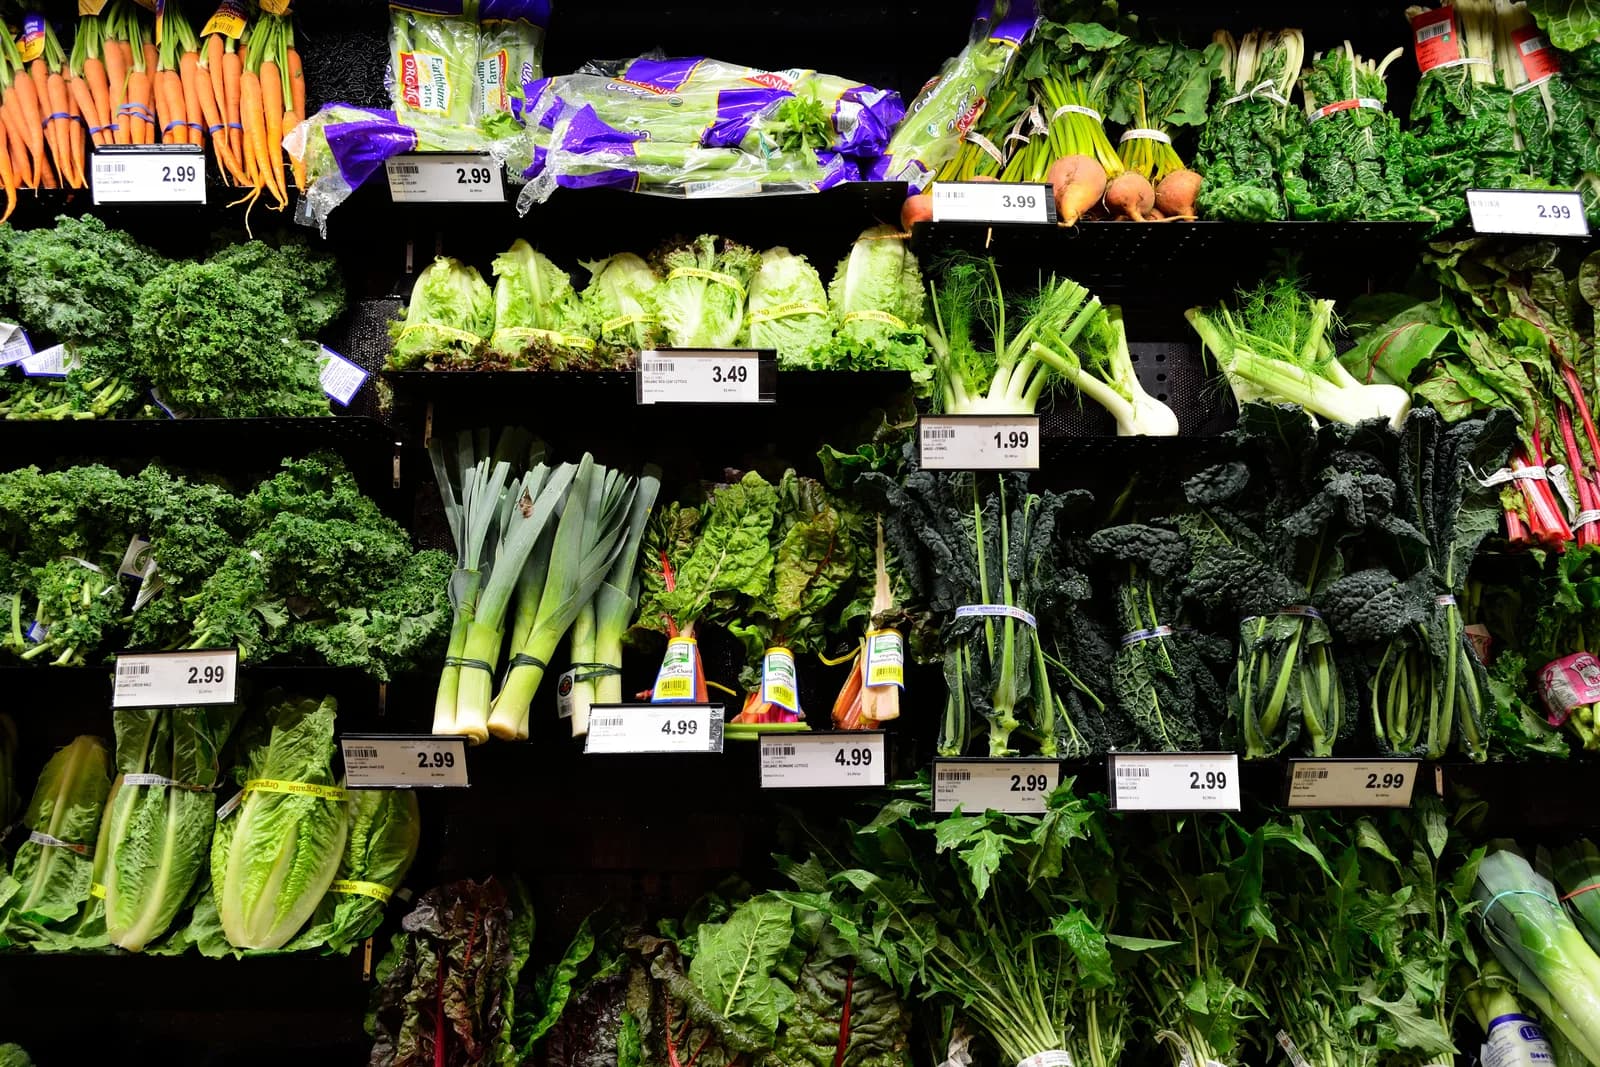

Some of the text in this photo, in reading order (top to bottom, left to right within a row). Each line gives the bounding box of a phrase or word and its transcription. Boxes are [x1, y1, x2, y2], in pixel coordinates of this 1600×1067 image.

[486, 59, 497, 85] Farm
[162, 165, 196, 182] 2.99
[456, 168, 491, 184] 2.99
[1002, 195, 1036, 209] 3.99
[1536, 204, 1571, 219] 2.99
[712, 365, 748, 383] 3.49
[993, 431, 1029, 449] 1.99
[187, 665, 225, 684] 2.99
[661, 719, 698, 735] 4.99
[417, 751, 455, 768] 2.99
[834, 747, 872, 766] 4.99
[1010, 774, 1048, 792] 2.99
[1189, 771, 1227, 790] 2.99
[1365, 773, 1405, 789] 2.99
